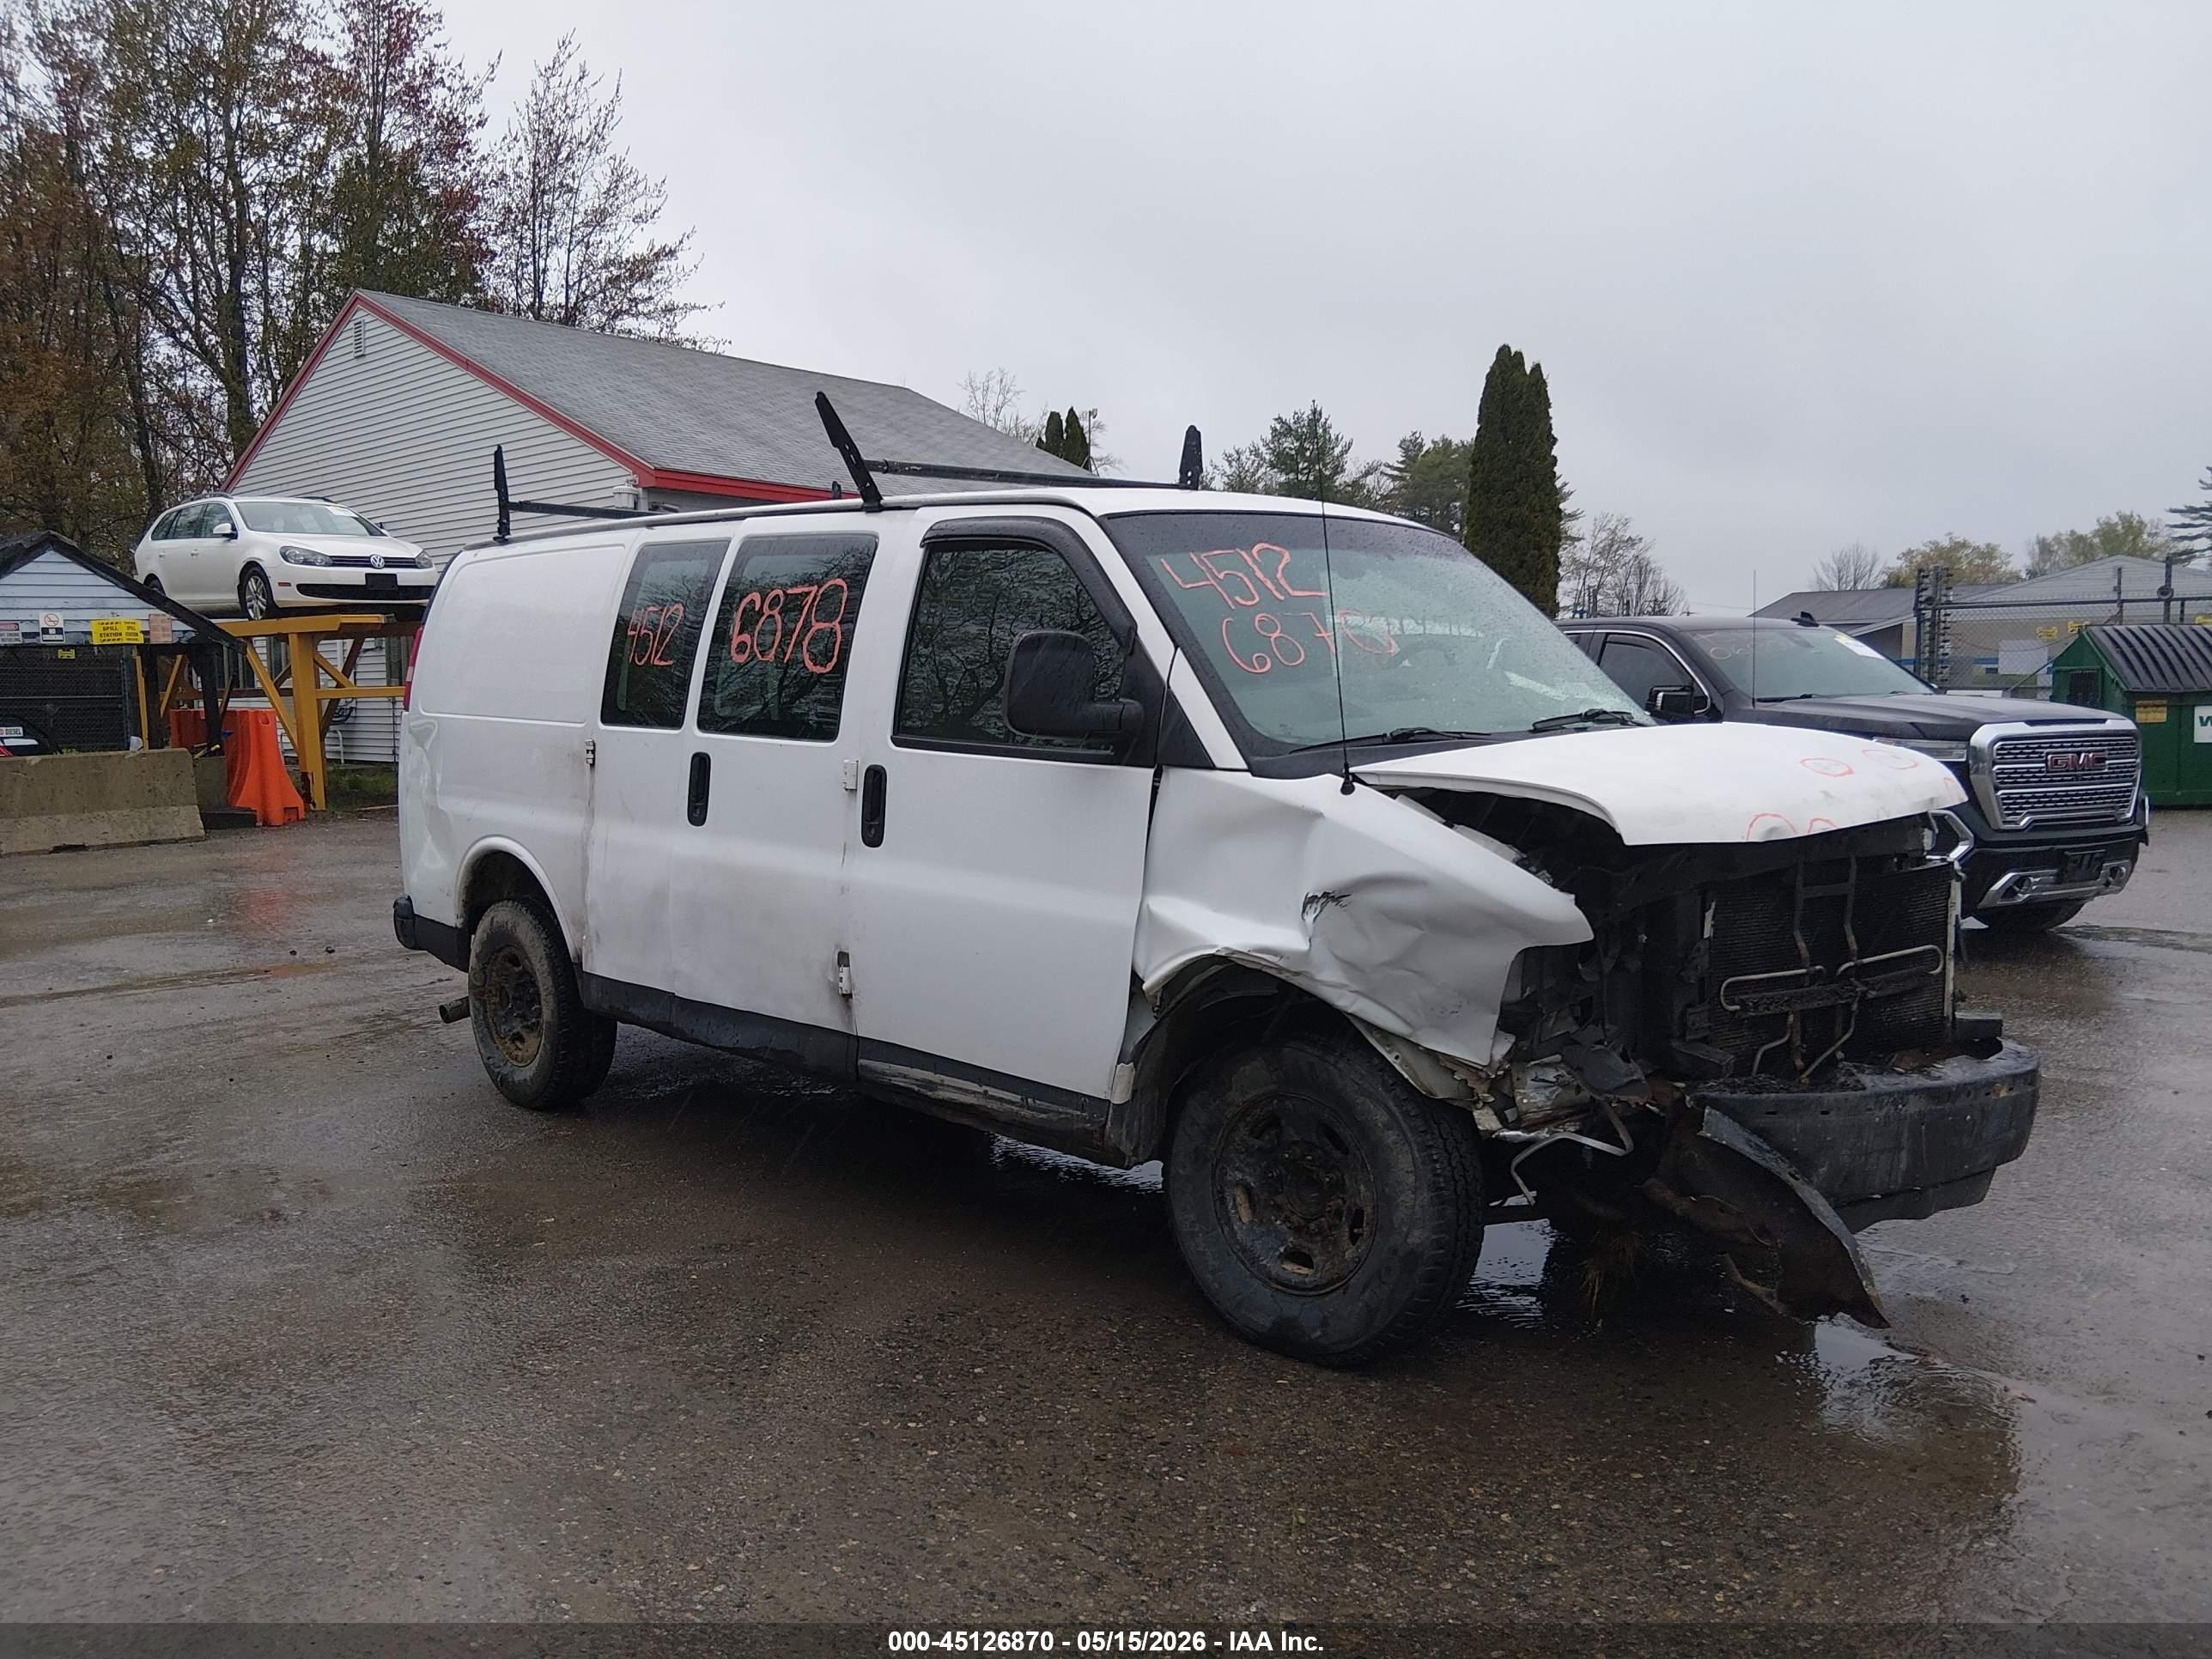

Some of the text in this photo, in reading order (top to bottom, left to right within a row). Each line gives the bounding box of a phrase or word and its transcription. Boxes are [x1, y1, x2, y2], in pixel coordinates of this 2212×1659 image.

[1160, 542, 1329, 609] 4512
[627, 603, 684, 666] 4512
[2047, 752, 2104, 771] GMC
